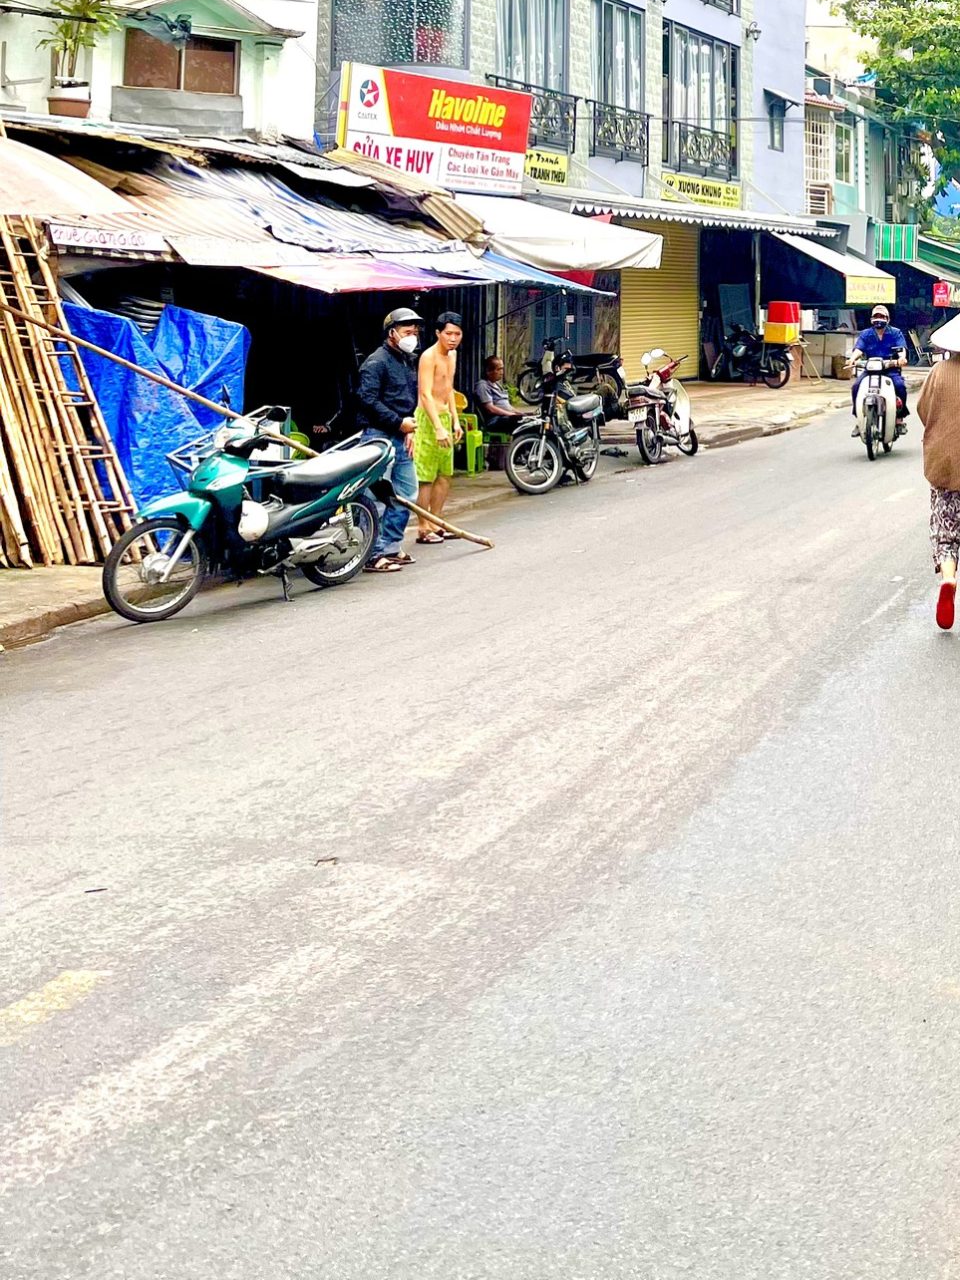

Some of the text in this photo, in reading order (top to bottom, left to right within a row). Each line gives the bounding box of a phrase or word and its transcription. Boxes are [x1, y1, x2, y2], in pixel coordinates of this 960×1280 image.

[428, 88, 507, 128] Havoline
[386, 146, 402, 168] XE
[406, 150, 434, 174] HUY
[490, 152, 510, 166] Trang
[481, 164, 490, 174] Xe
[530, 166, 550, 180] TRANH
[702, 184, 722, 198] KHUNG
